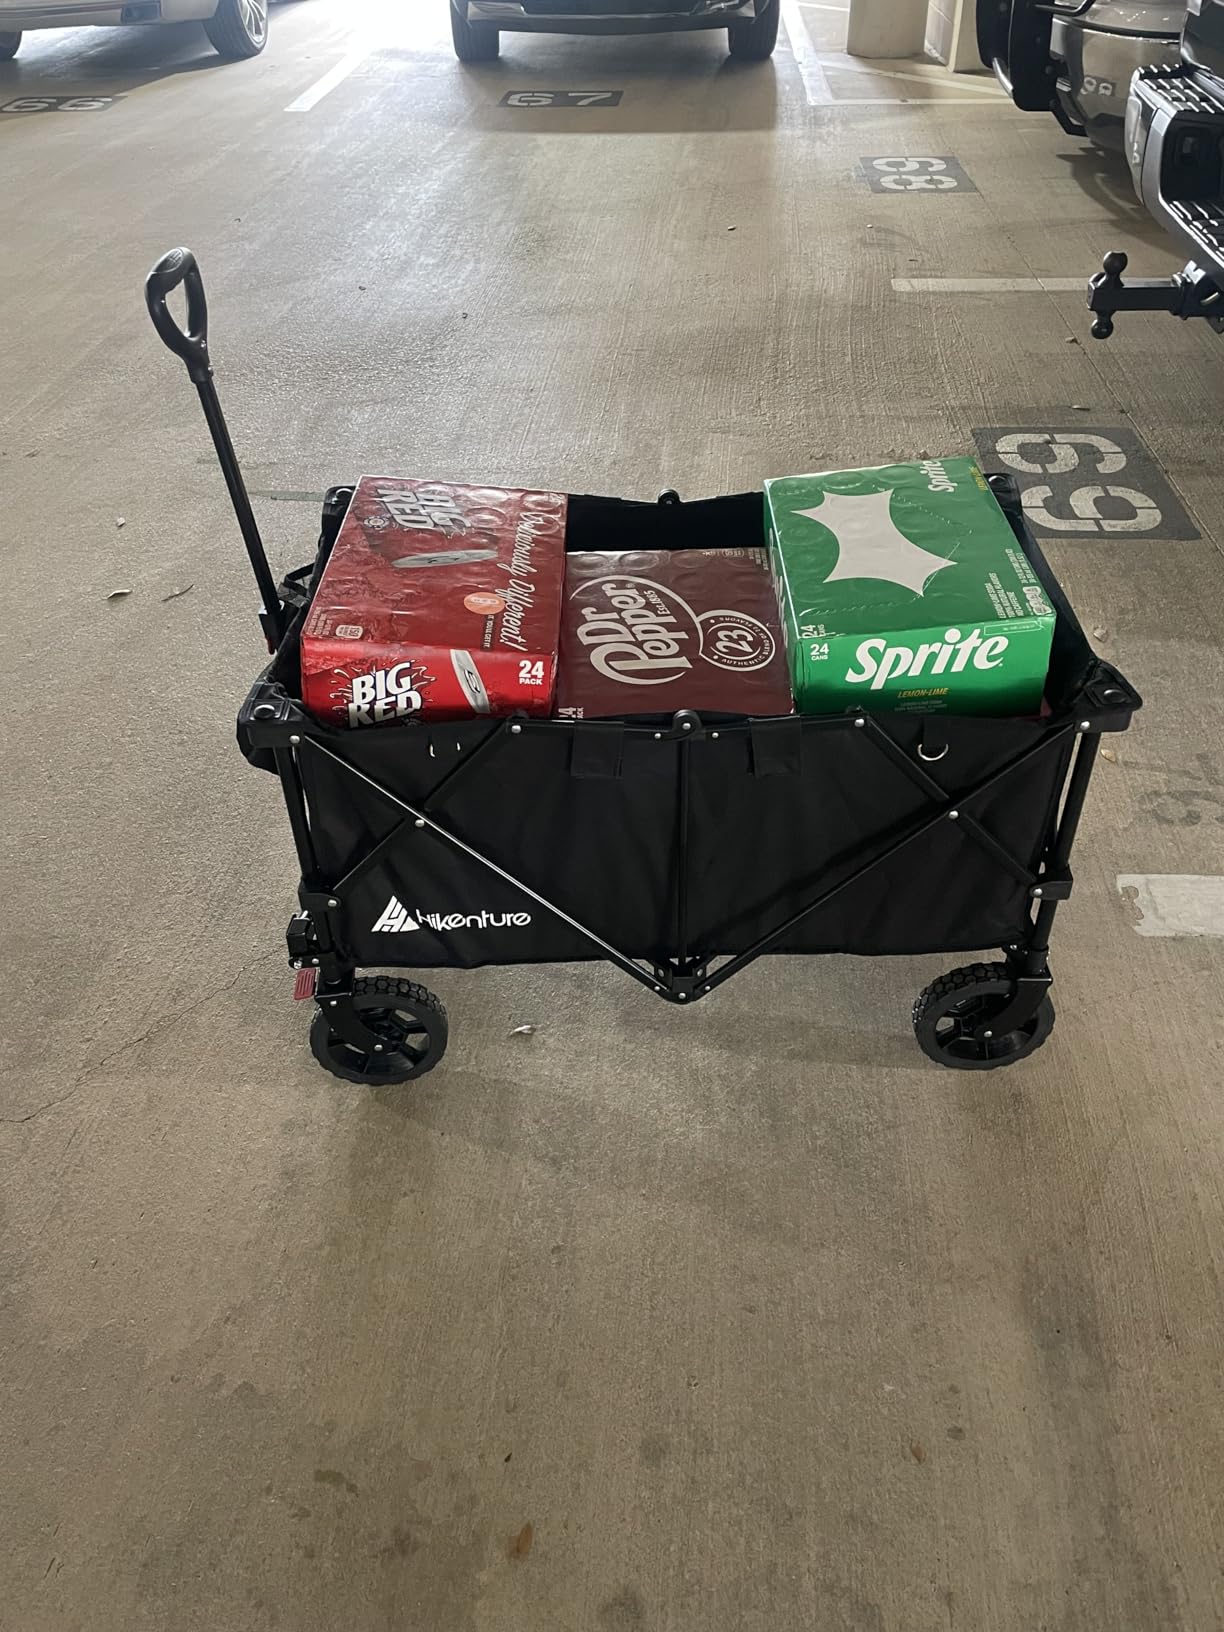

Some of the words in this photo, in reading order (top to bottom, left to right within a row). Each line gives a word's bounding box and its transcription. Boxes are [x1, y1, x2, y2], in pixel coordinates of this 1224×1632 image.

[1, 97, 112, 112] 66
[507, 92, 612, 106] 67
[872, 157, 958, 191] 68
[996, 432, 1162, 532] 69
[377, 489, 435, 529] RED
[416, 493, 472, 528] BIG
[495, 578, 536, 652] Different!
[576, 606, 637, 645] Dr
[590, 583, 693, 685] Pepper
[715, 629, 754, 652] 23
[761, 639, 771, 655] BLEND
[810, 643, 829, 656] 24
[519, 659, 544, 678] 24
[845, 628, 1009, 690] Sprite
[352, 662, 412, 704] BIG
[897, 687, 949, 699] LEMON-LIME
[348, 690, 422, 729] RED
[415, 908, 531, 931] hikenture
